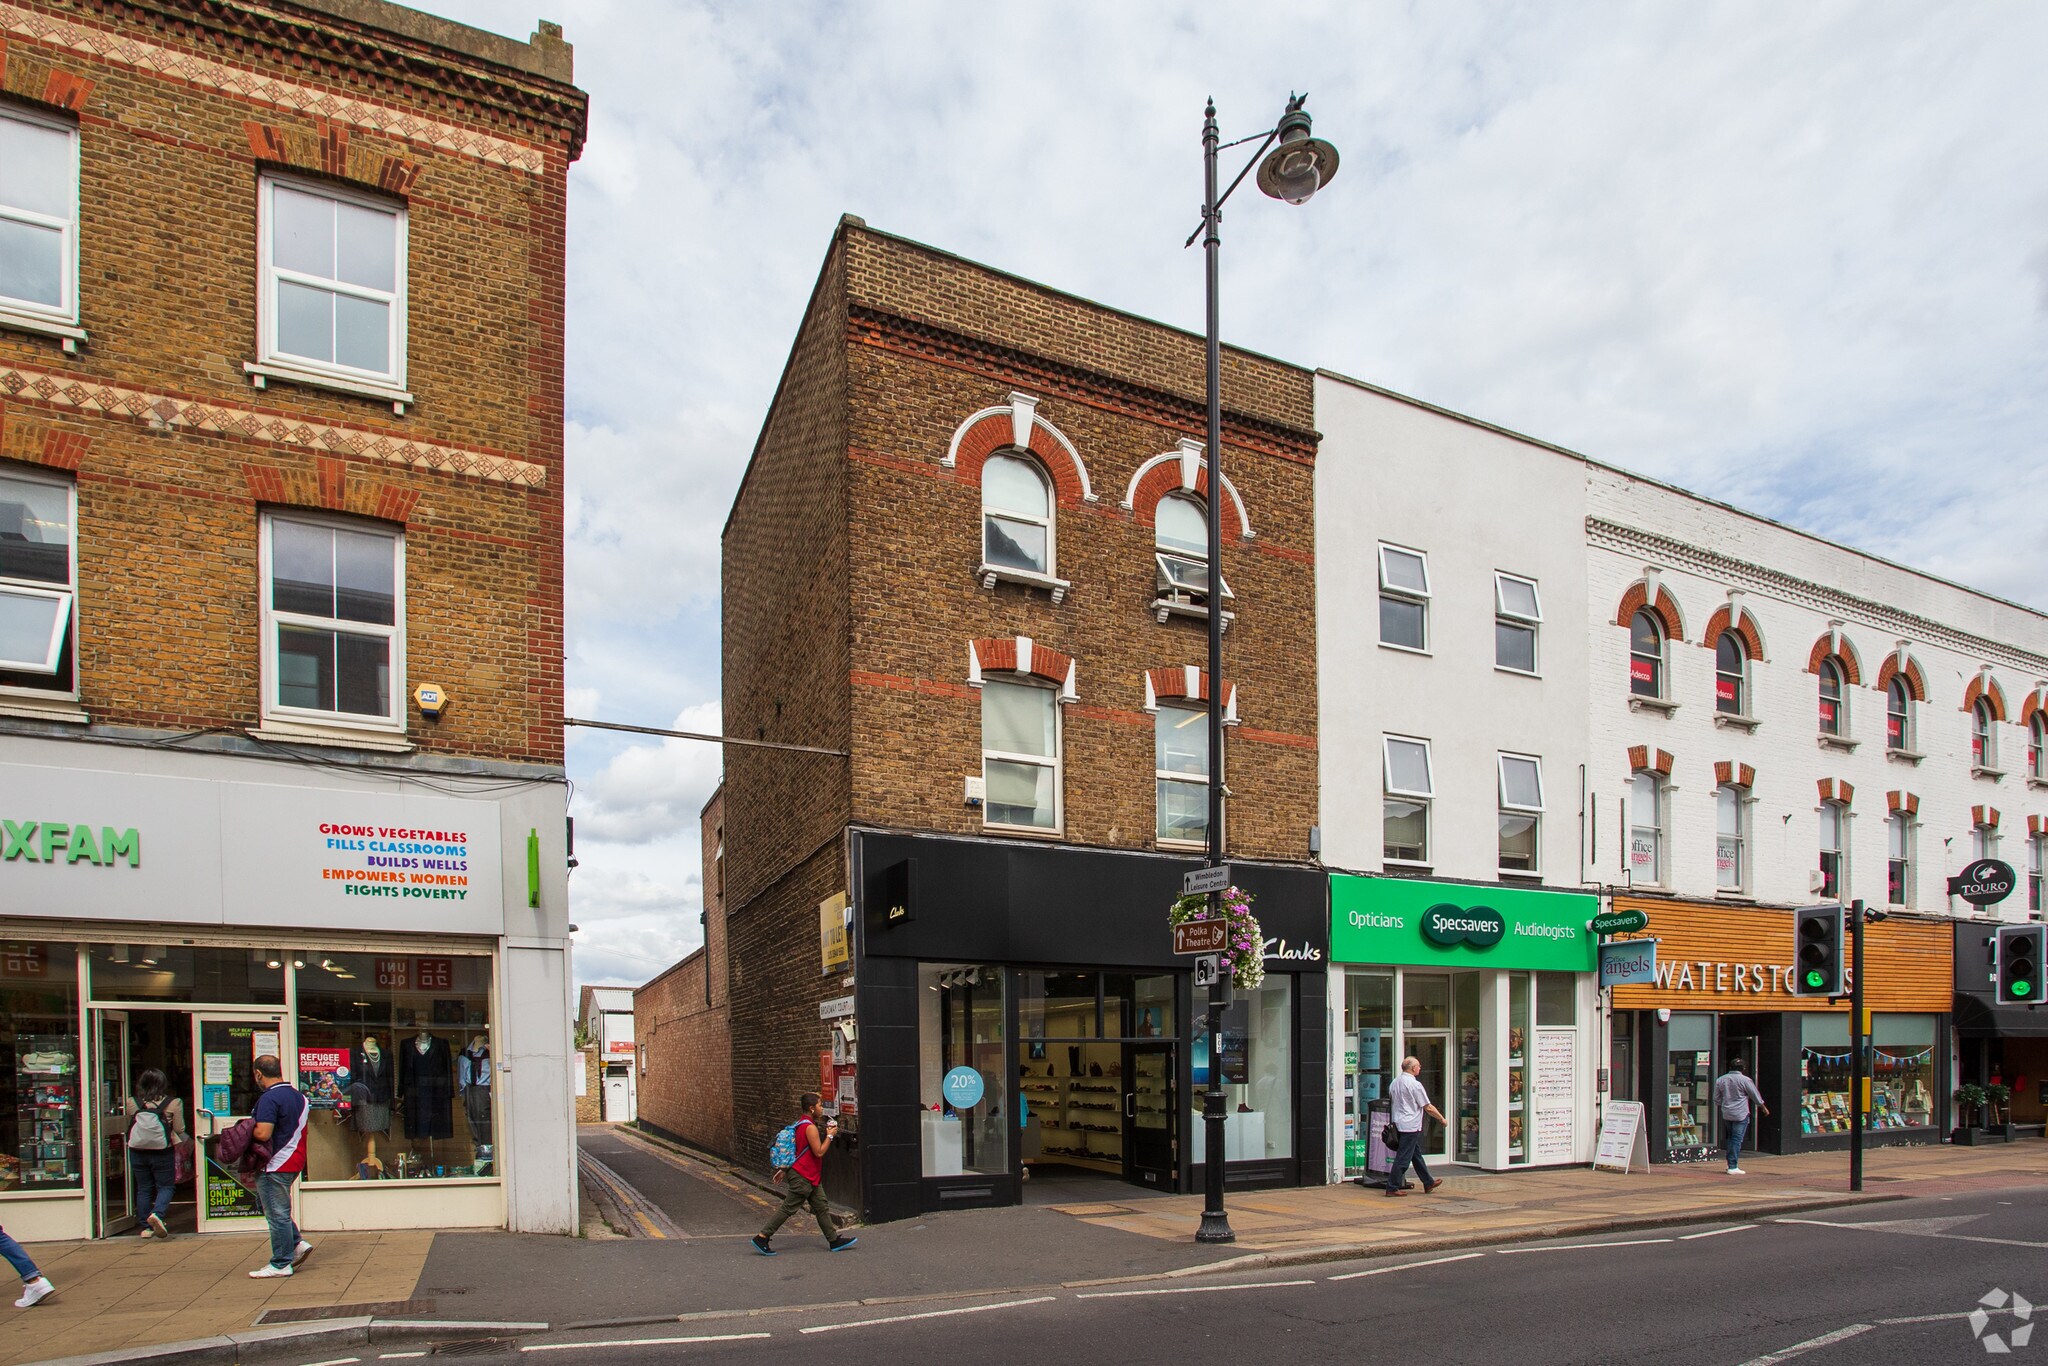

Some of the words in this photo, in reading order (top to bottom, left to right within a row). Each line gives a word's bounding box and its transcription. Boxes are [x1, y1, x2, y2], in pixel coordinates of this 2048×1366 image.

[421, 692, 437, 701] ADT
[319, 823, 374, 837] GROWS
[378, 827, 467, 843] VEGETABLES
[0, 819, 140, 868] XFAM
[327, 838, 365, 851] FILLS
[369, 841, 467, 857] CLASSROOMS
[367, 856, 419, 868] BUILDS
[422, 859, 468, 871] WELLS
[1716, 858, 1735, 869] ngels
[322, 869, 406, 883] EMPOWERS
[410, 873, 468, 886] WOMEN
[1195, 871, 1224, 881] Wimbledon
[345, 884, 398, 897] FIGHTS
[402, 887, 468, 900] POVERTY
[1190, 882, 1208, 891] Leisure
[1209, 880, 1228, 888] Centre
[1961, 881, 2008, 894] TOURO
[1349, 911, 1404, 929] Opticians
[1432, 914, 1499, 933] Specsavers
[1595, 915, 1639, 930] Specsavers
[1189, 927, 1208, 936] Polka
[1514, 922, 1576, 941] Audiologists
[1185, 936, 1211, 947] Theatre
[1605, 955, 1650, 978] angels
[1655, 960, 1853, 994] WATERSTOS
[300, 1053, 340, 1061] REFUGEE
[951, 1074, 976, 1088] 20%
[210, 1189, 244, 1198] ONLINE
[210, 1197, 236, 1206] SHOP
